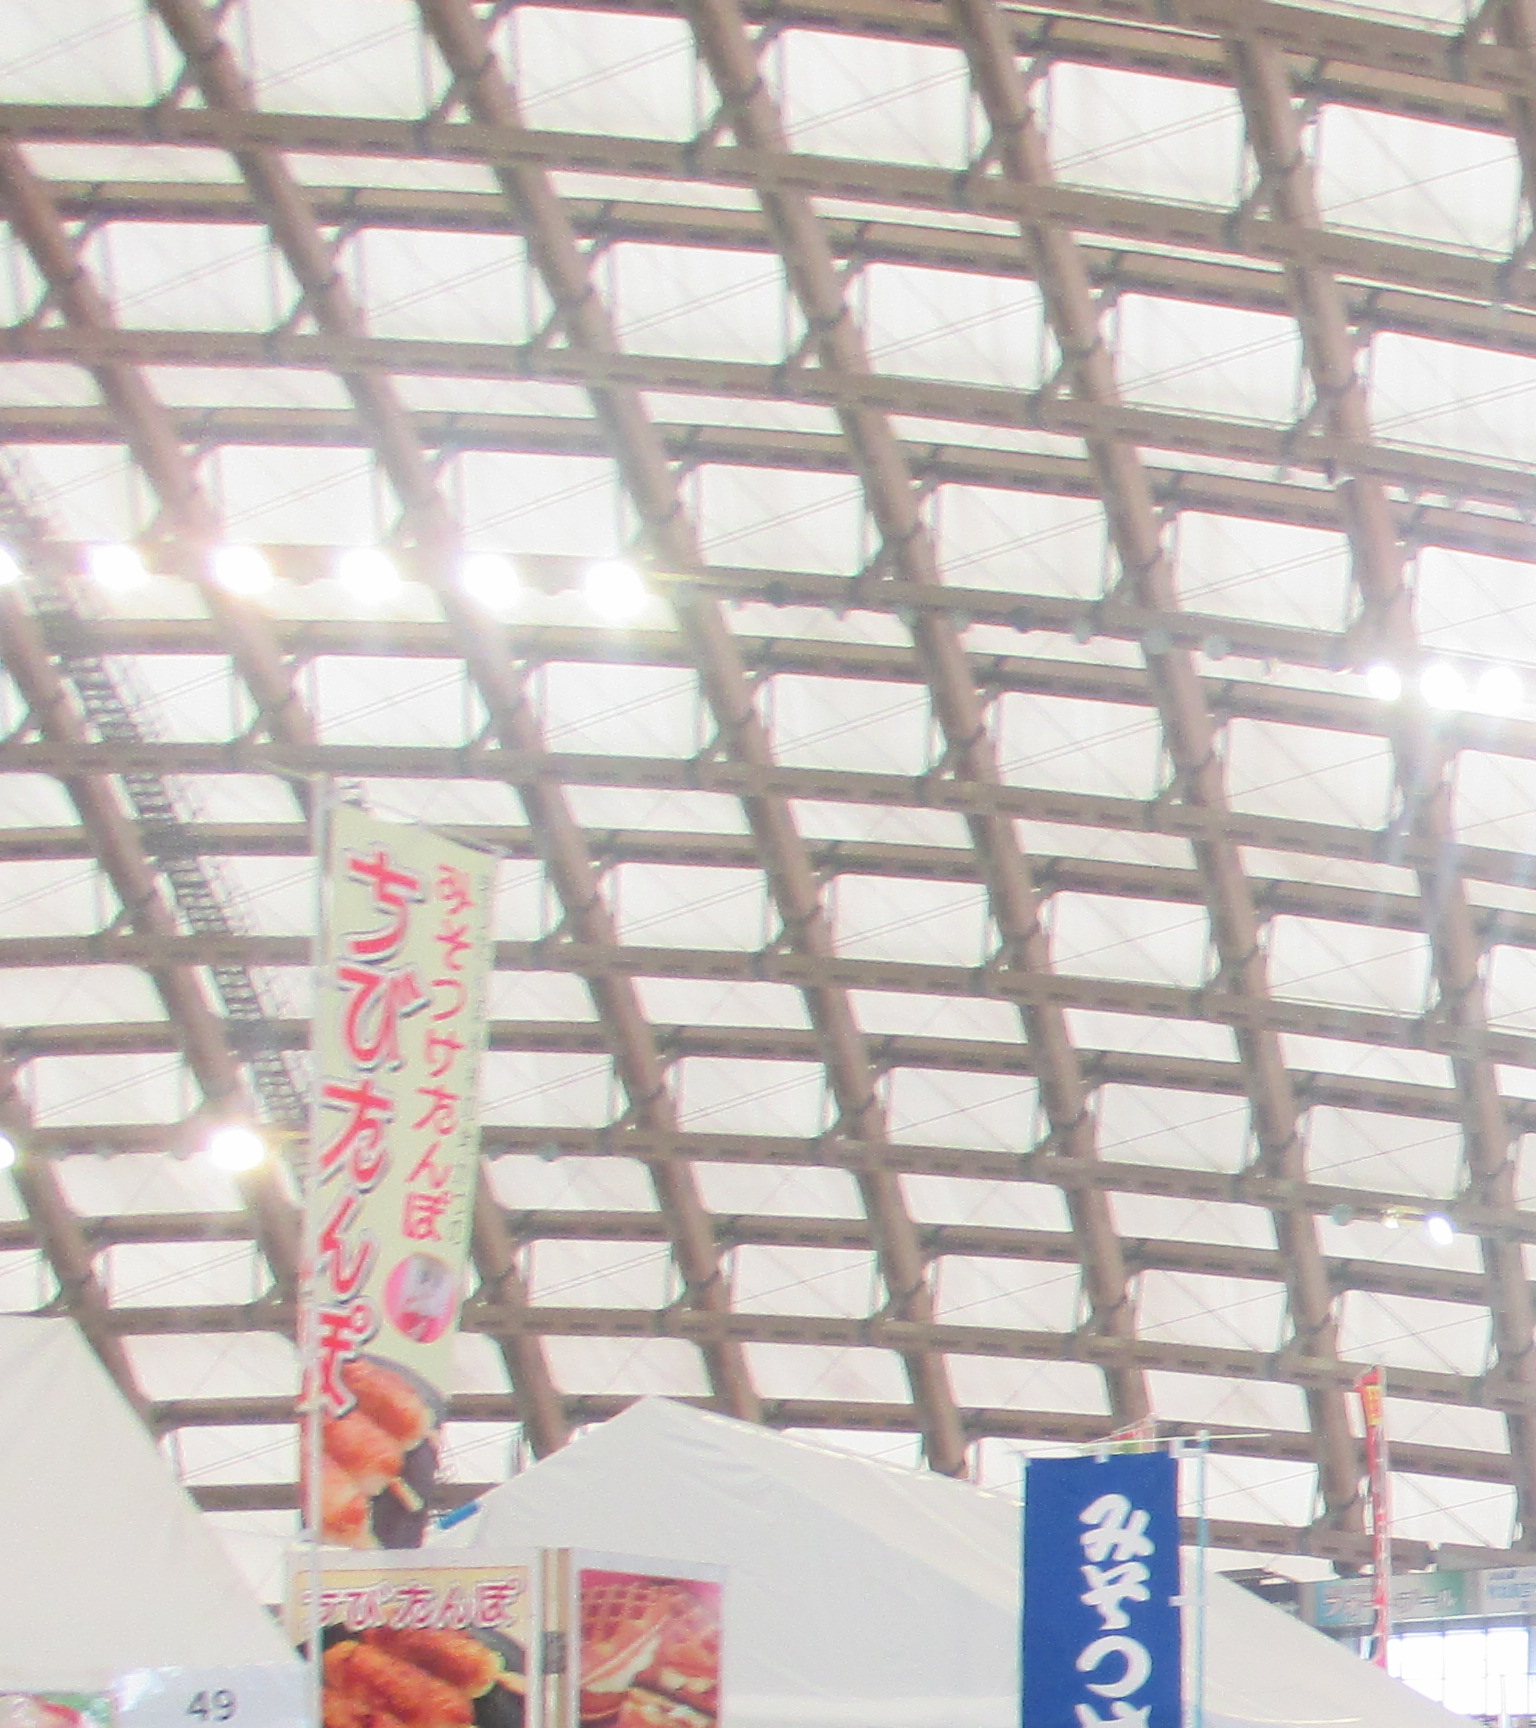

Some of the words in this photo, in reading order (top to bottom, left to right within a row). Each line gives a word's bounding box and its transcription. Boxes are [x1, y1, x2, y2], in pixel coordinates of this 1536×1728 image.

[312, 850, 422, 1412] ちびたんぽ
[402, 862, 478, 1241] みそつけたんぽ
[186, 1688, 237, 1722] 49
